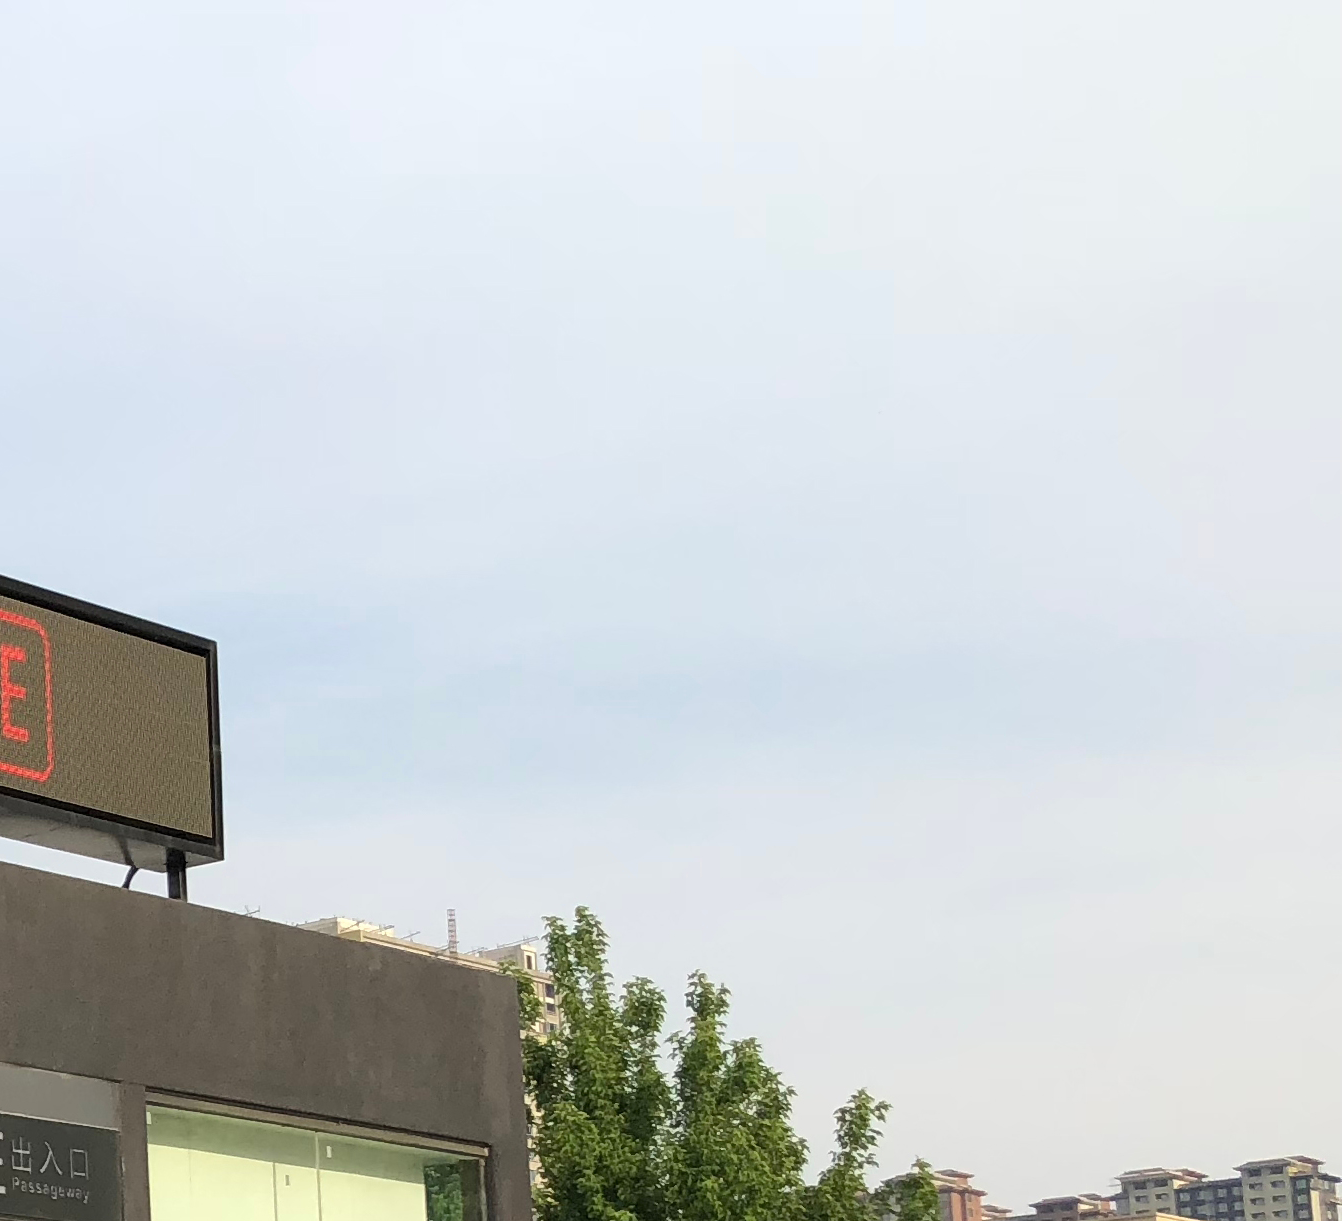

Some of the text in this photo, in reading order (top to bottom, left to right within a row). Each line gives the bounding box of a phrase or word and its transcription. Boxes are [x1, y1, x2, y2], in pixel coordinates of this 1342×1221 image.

[0, 642, 34, 743] E
[11, 1136, 89, 1180] 出入口
[12, 1176, 90, 1204] Passageway
